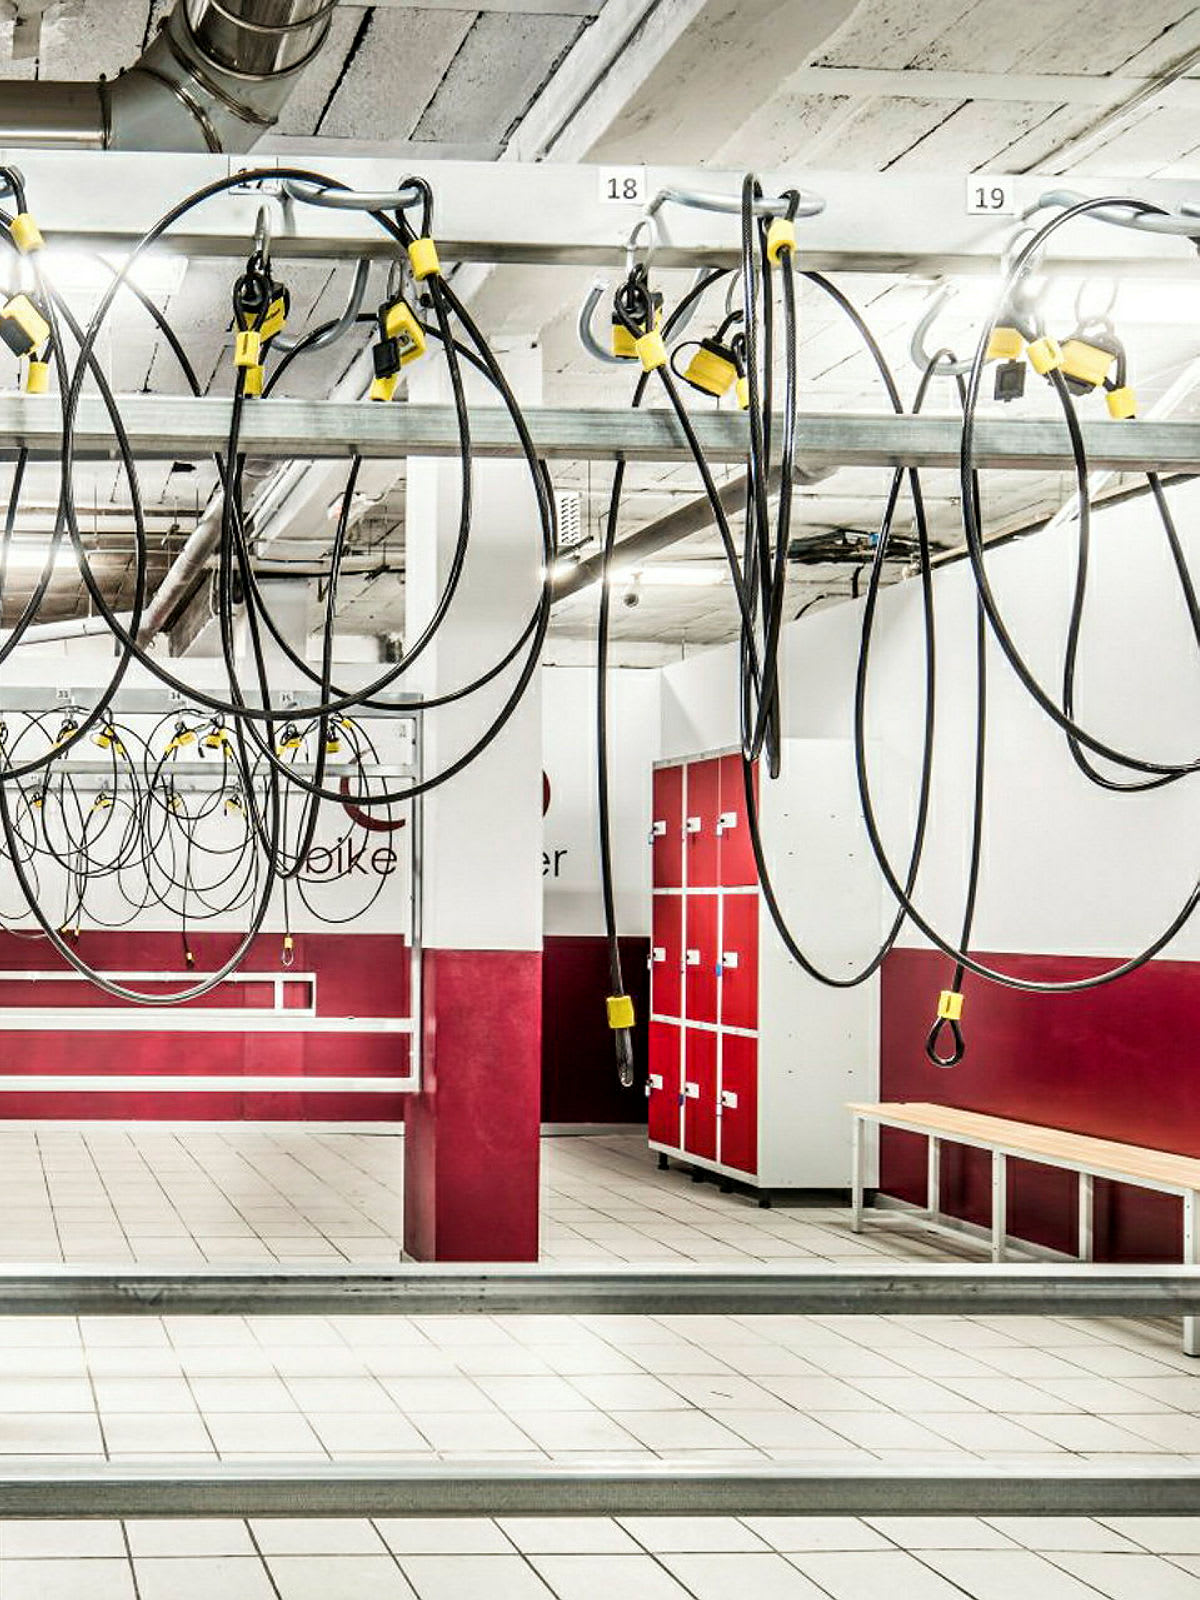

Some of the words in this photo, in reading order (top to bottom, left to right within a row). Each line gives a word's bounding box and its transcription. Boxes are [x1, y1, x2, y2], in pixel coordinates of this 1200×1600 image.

[607, 177, 638, 200] 18
[975, 187, 1005, 210] 19
[306, 836, 398, 875] bike
[542, 850, 568, 877] r
